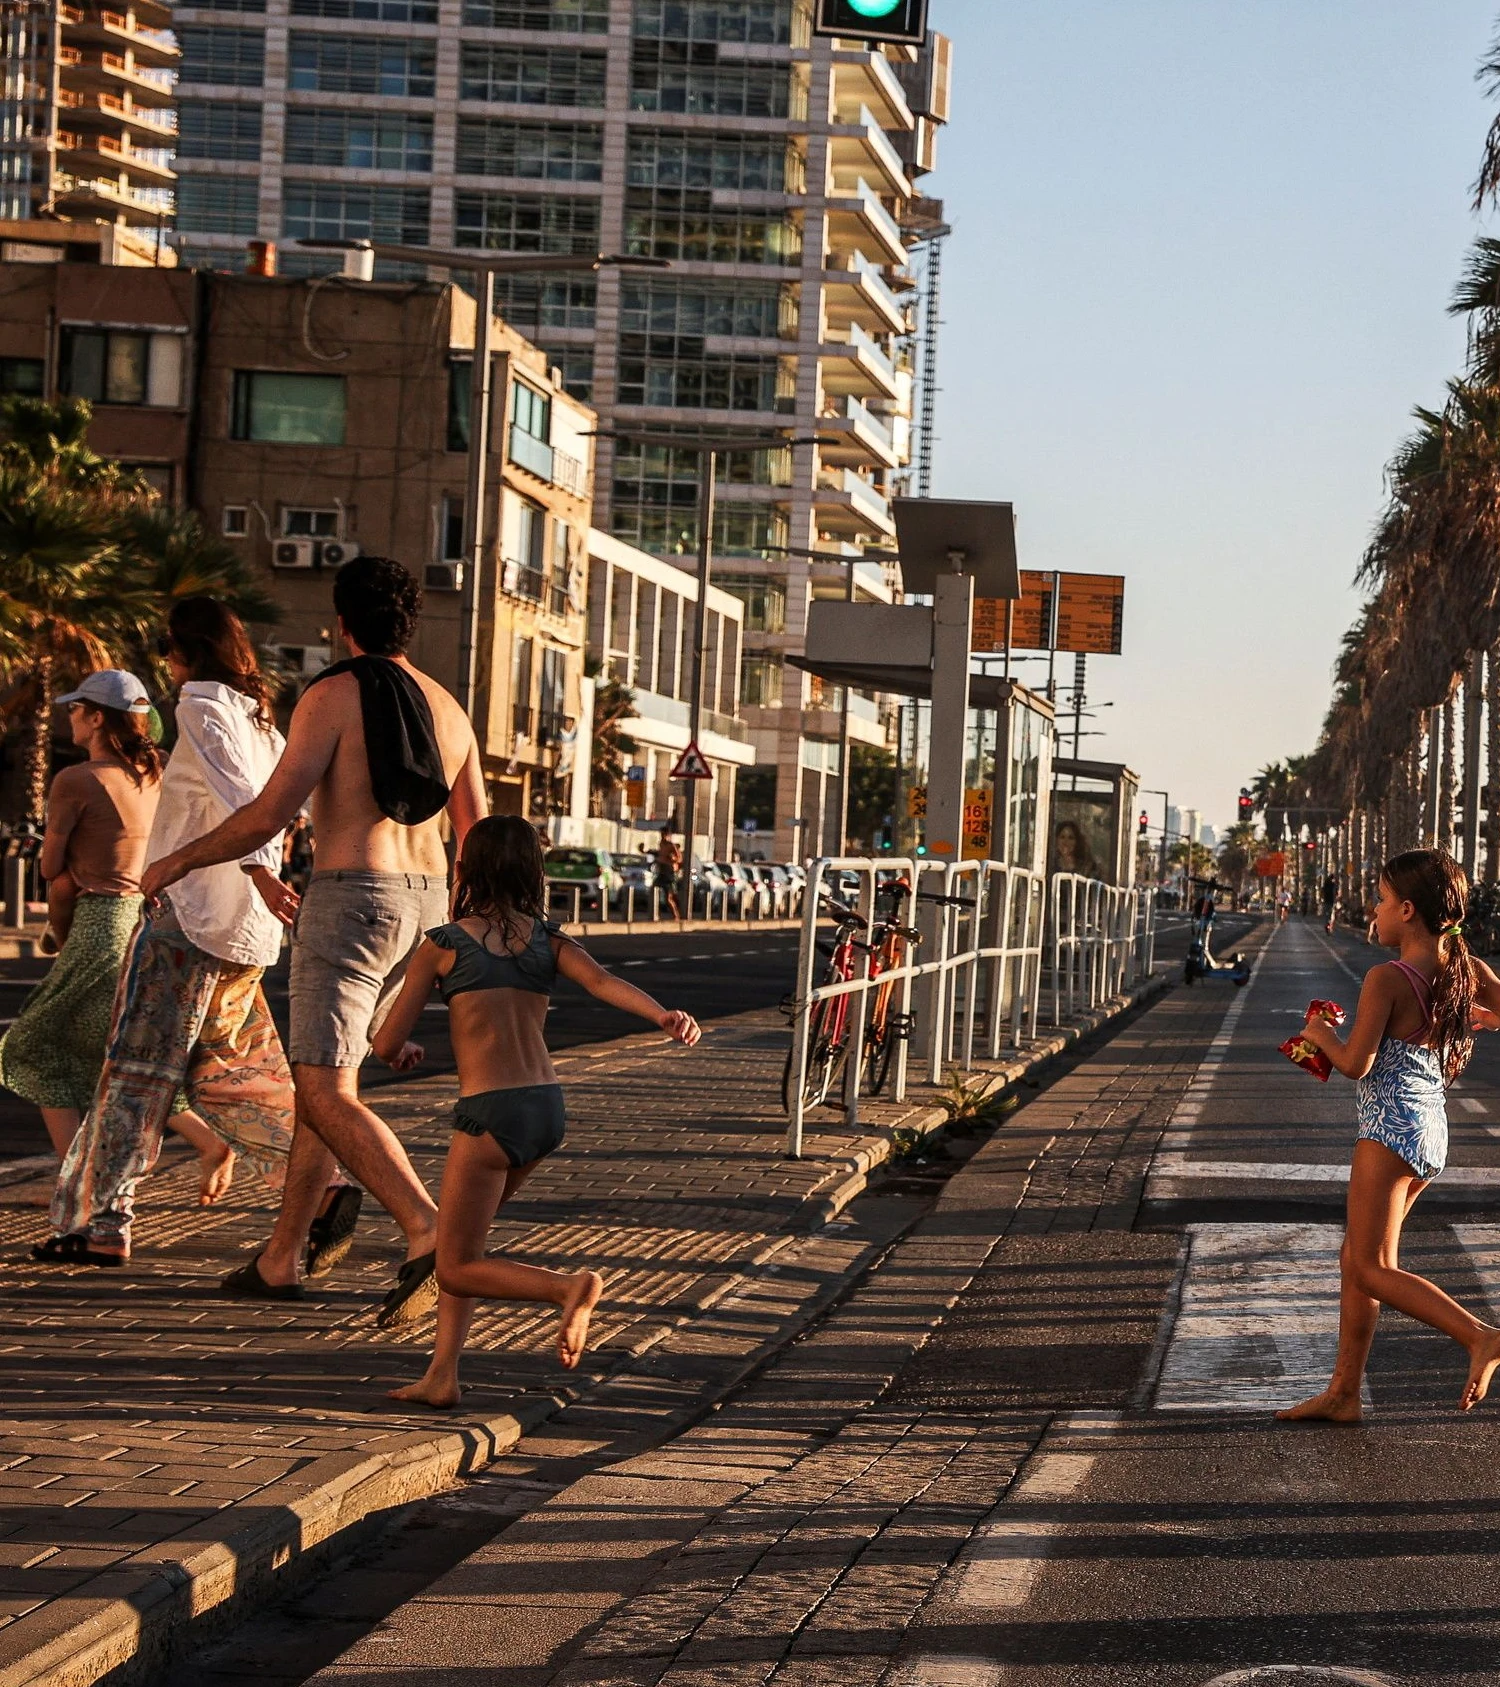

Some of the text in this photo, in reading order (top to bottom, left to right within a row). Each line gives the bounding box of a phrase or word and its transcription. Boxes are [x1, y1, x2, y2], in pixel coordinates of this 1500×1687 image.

[977, 791, 986, 802] 4
[965, 805, 989, 818] 161
[971, 836, 987, 848] 48
